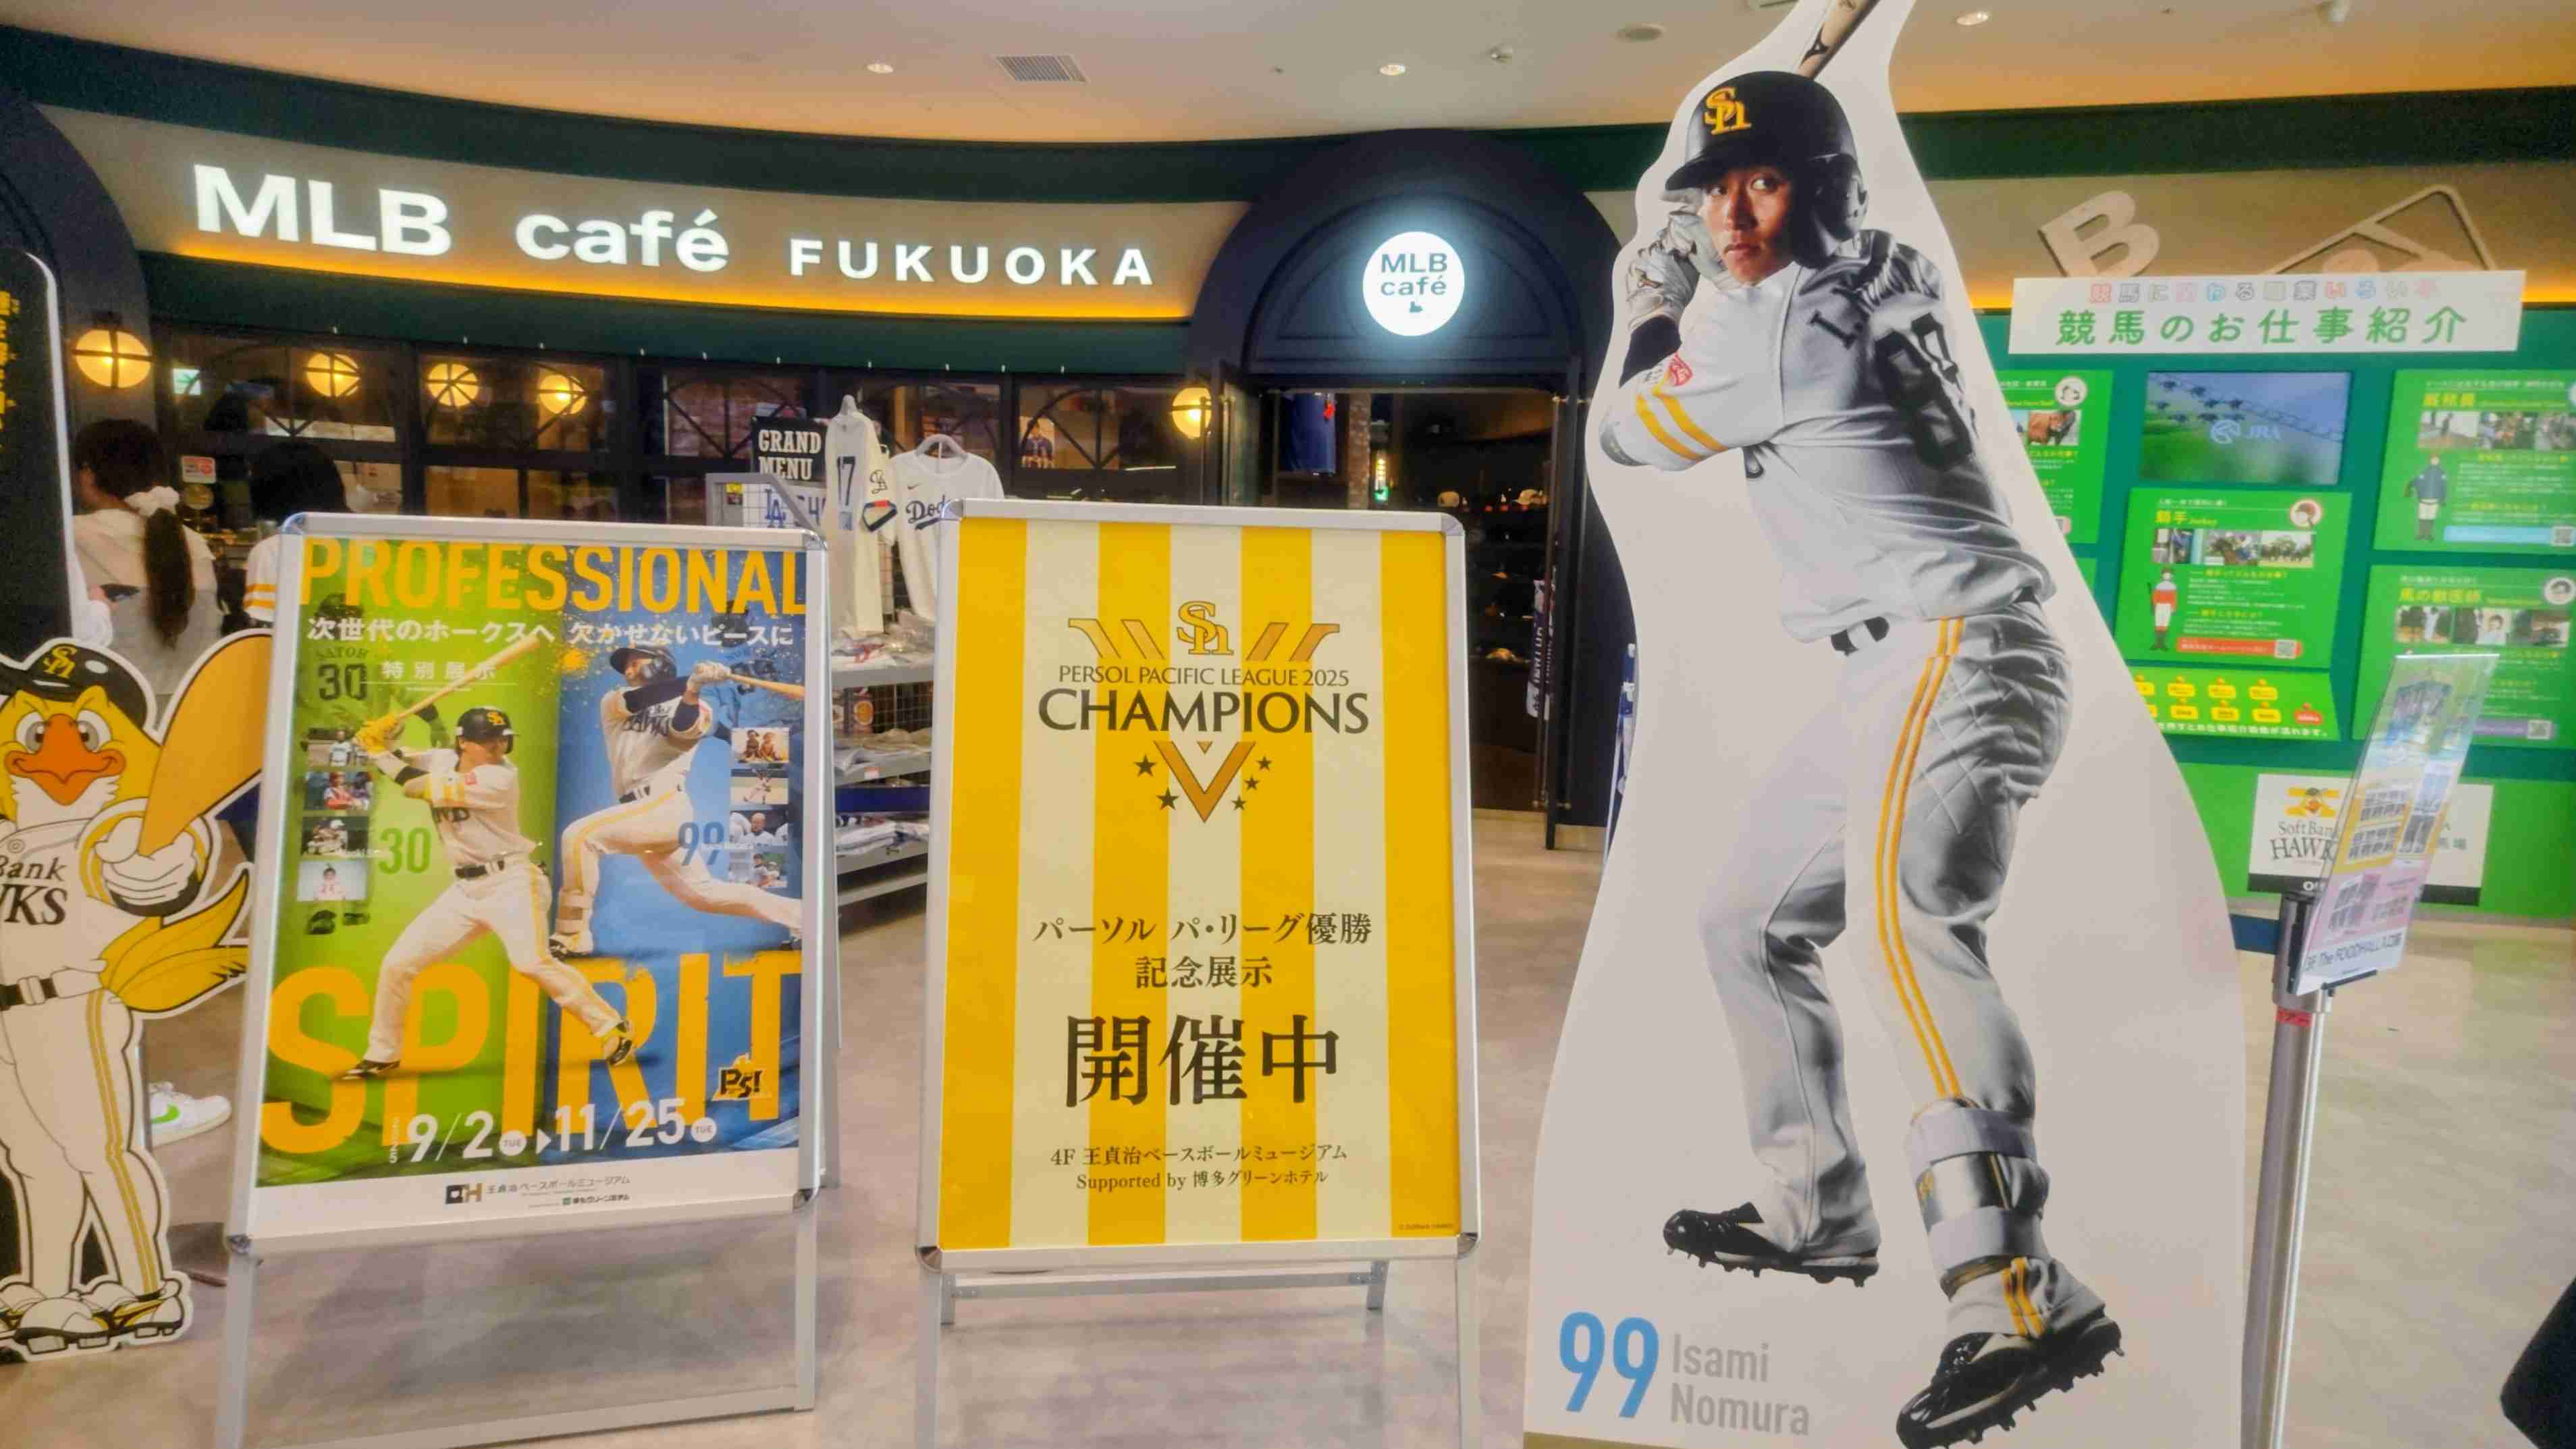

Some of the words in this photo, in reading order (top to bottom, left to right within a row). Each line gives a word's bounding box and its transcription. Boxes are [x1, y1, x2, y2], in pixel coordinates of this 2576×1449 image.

[193, 163, 452, 257] MLB
[515, 208, 730, 273] café
[790, 238, 1153, 286] FUKUOKA
[1380, 253, 1448, 273] MLB
[1380, 275, 1447, 296] café
[2055, 305, 2467, 346] 競馬のお仕事紹介
[758, 429, 822, 454] GRAND
[758, 456, 813, 481] MENU
[837, 455, 856, 506] 17
[301, 537, 807, 614] PROFESSIONAL
[308, 616, 556, 642] 次世代のホークスへ
[569, 622, 793, 646] 欠かせないピースに
[318, 662, 367, 701] 30
[1059, 665, 1135, 684] PERSOL
[1139, 666, 1215, 685] PACIFIC
[1221, 668, 1299, 687] LEAGUE
[1303, 669, 1349, 687] 2025
[1038, 687, 1369, 735] CHAMPIONS
[377, 827, 432, 874] 30
[1031, 916, 1156, 945] パーソル
[1170, 912, 1372, 945] パ・リーグ優勝
[1134, 955, 1274, 990] 記念展示
[260, 951, 802, 1154] SPIRIT
[1065, 1013, 1340, 1108] 開催中
[406, 1109, 494, 1163] 9/2
[502, 1138, 522, 1148] TUE
[554, 1097, 685, 1152] 11/25
[695, 1125, 714, 1134] TUE
[1050, 1148, 1075, 1166] 4F
[1082, 1142, 1348, 1166] 王貞治ベースボールミュージアム
[1075, 1172, 1161, 1193] Supported
[1166, 1171, 1187, 1190] by
[1192, 1167, 1329, 1189] 博多グリーンホテル
[1559, 1311, 1659, 1419] 99
[1670, 1334, 1769, 1383] Isami
[1669, 1382, 1810, 1437] Nomura
